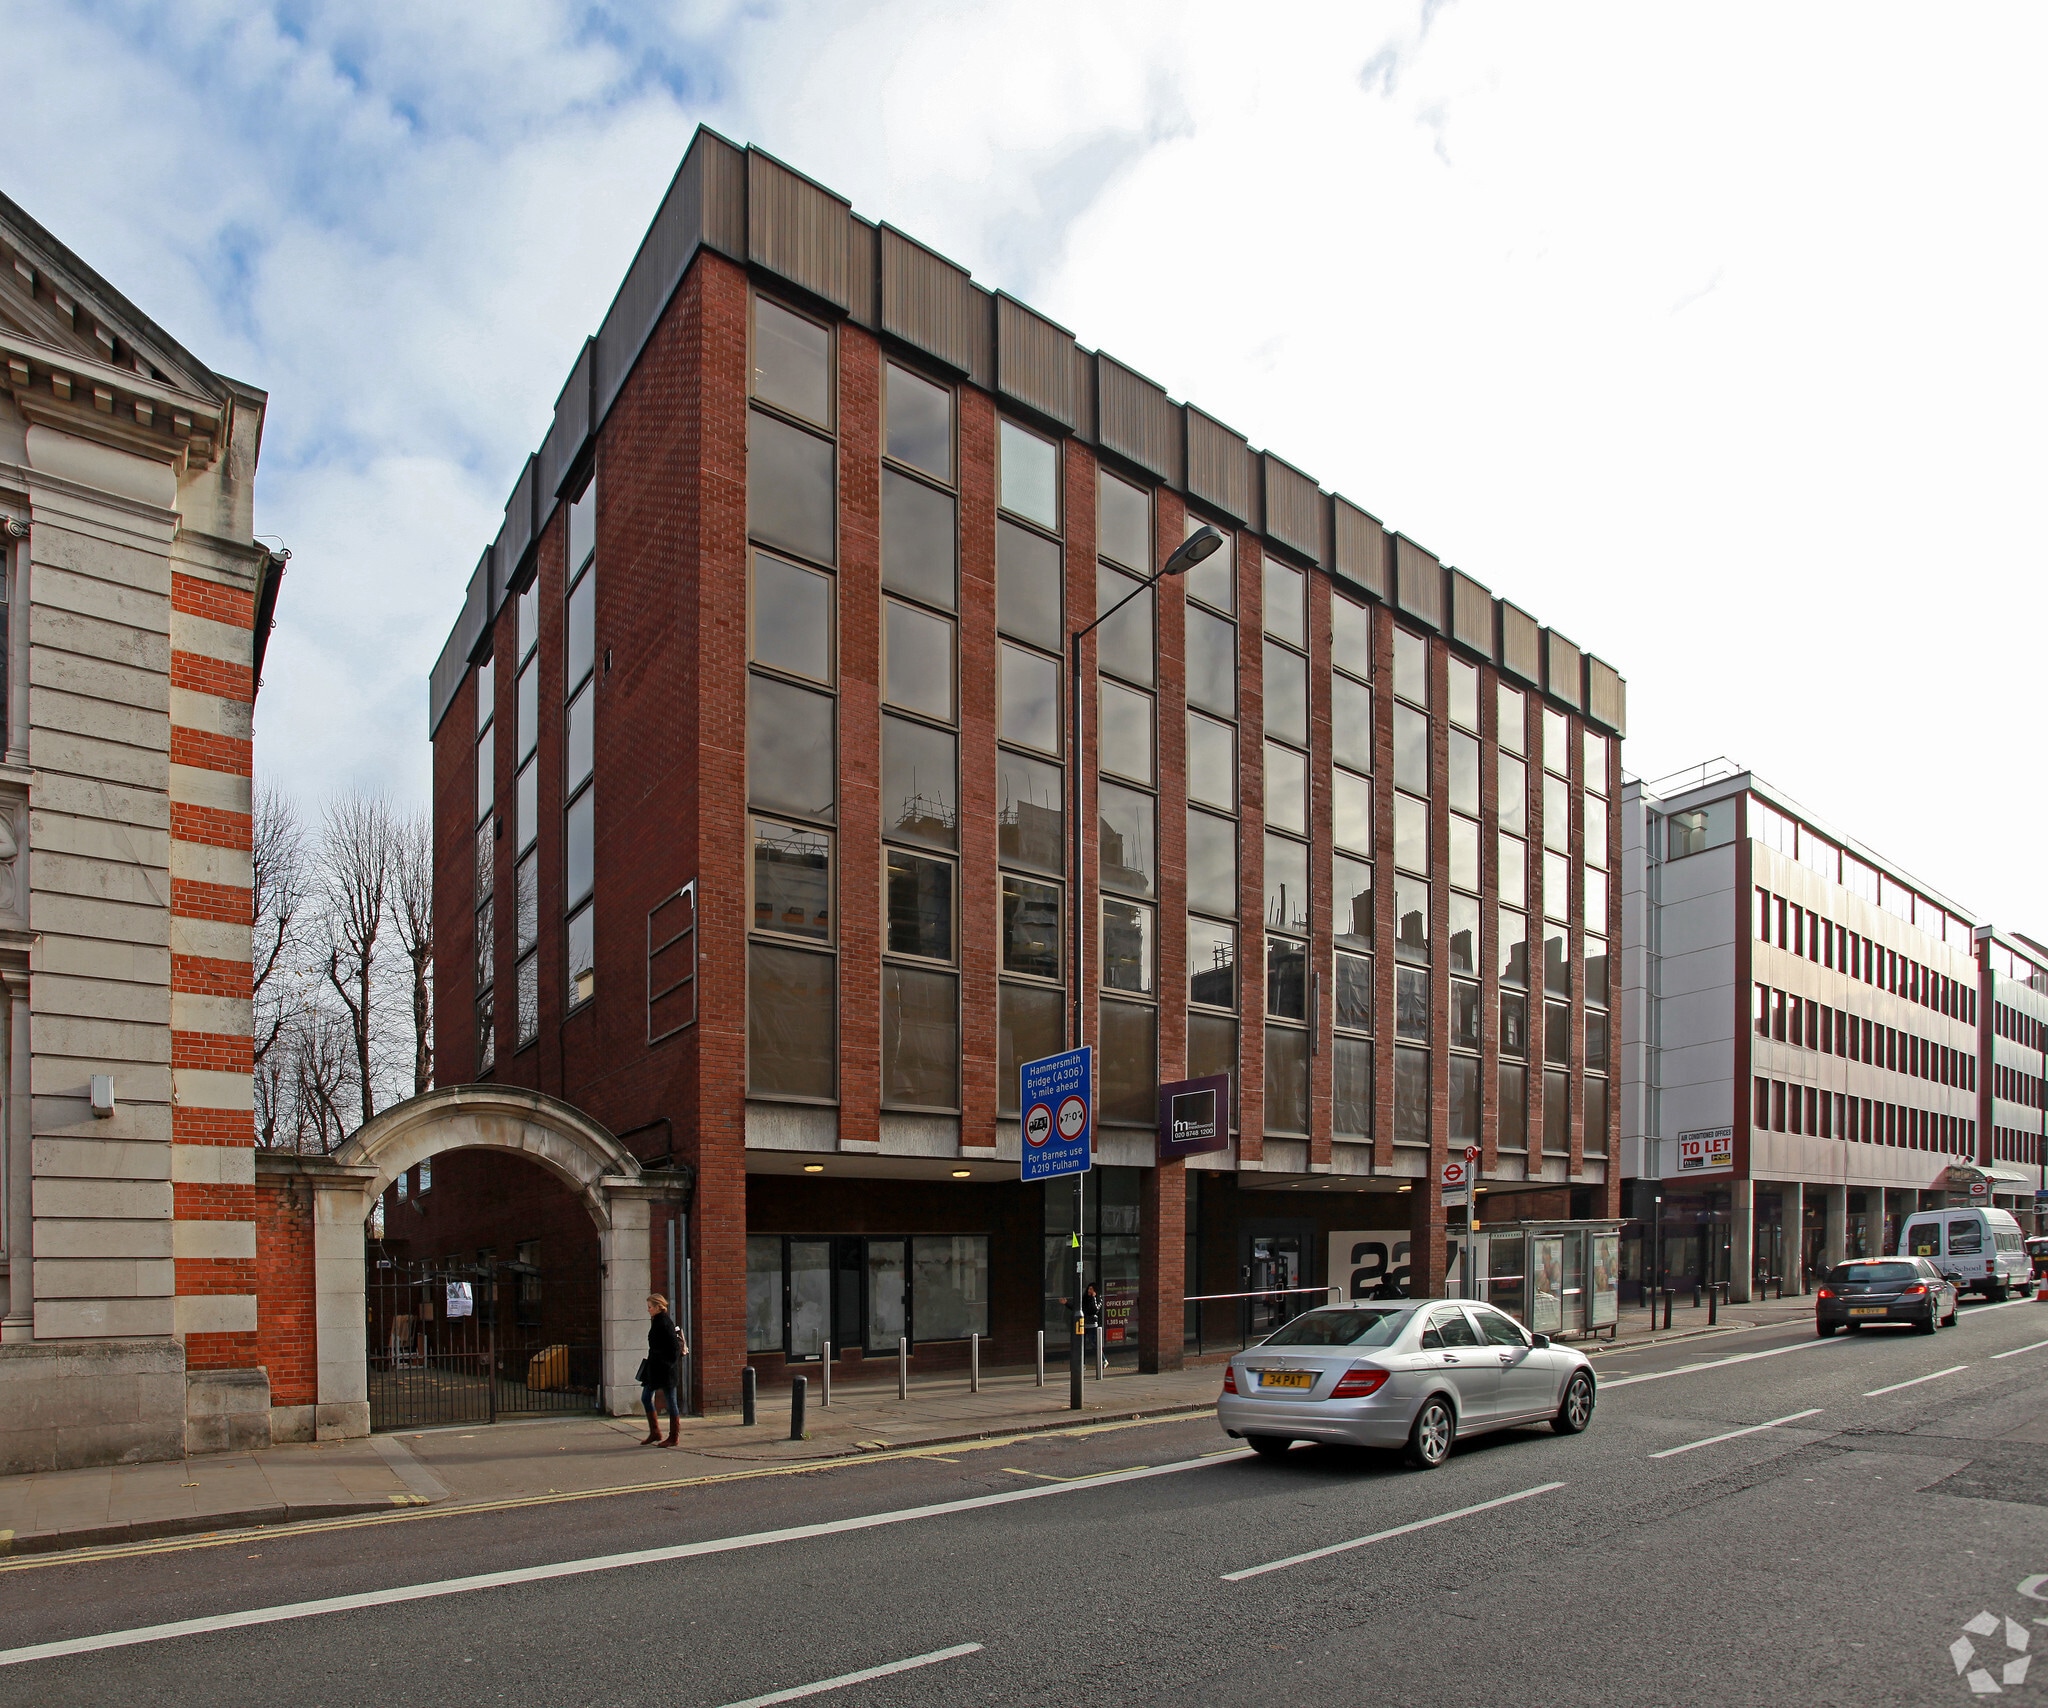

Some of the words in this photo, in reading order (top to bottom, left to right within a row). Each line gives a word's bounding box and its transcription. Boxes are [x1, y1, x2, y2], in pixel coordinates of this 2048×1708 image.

[1030, 1054, 1081, 1076] Hammersmith
[1027, 1075, 1051, 1089] Bridge
[1038, 1085, 1054, 1098] mile
[1056, 1079, 1079, 1093] ahead
[1715, 1129, 1731, 1137] OFFICES
[1466, 1147, 1474, 1159] R
[1681, 1142, 1700, 1155] TO
[1705, 1138, 1731, 1153] LET
[1028, 1153, 1040, 1164] For
[1042, 1148, 1067, 1161] Barnes
[1069, 1146, 1083, 1156] use
[1052, 1158, 1079, 1171] Fulham
[1954, 1264, 1982, 1272] School
[1106, 1308, 1116, 1318] TO
[1118, 1308, 1131, 1316] LET
[1270, 1375, 1281, 1385] 34
[1284, 1375, 1303, 1386] PAT
